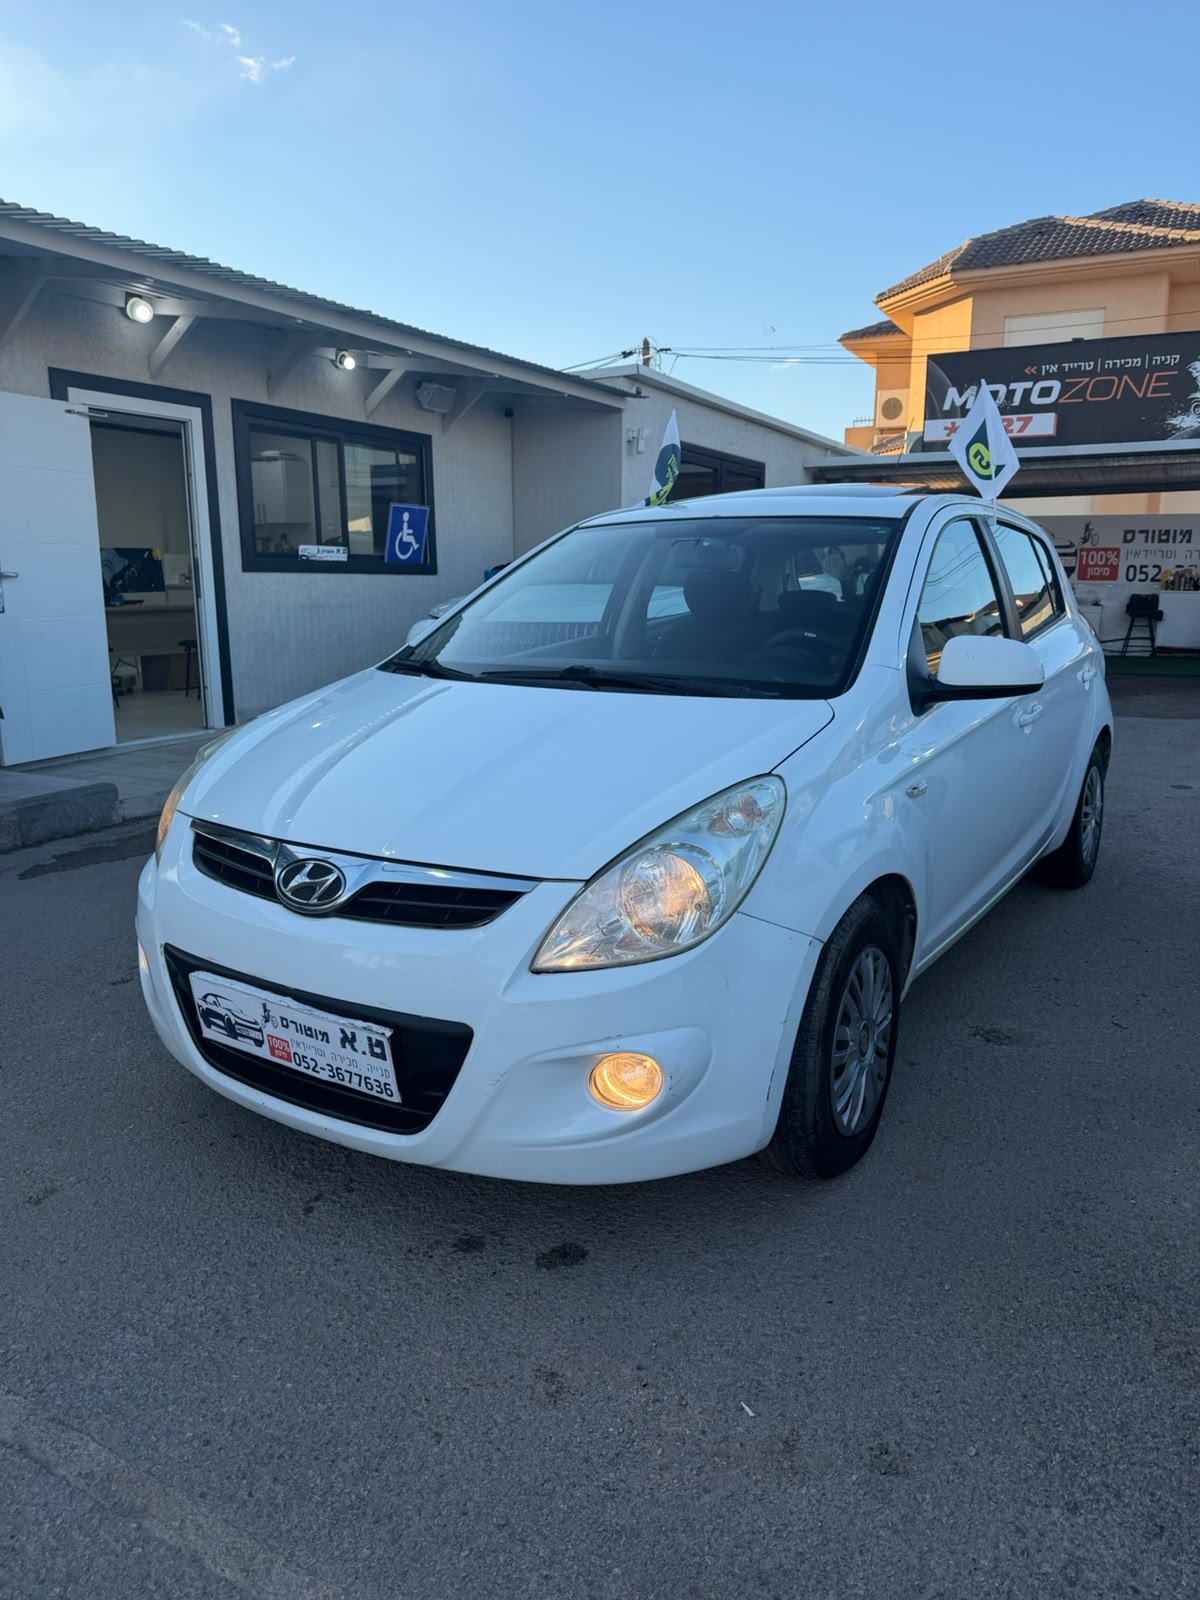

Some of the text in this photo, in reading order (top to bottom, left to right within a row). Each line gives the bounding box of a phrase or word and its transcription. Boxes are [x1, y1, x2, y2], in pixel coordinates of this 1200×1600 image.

[1042, 354, 1180, 376] קניה מכירה טרייד אין
[1081, 551, 1118, 565] 100%
[268, 1036, 290, 1053] 100%
[293, 1052, 394, 1098] 052-3677636
